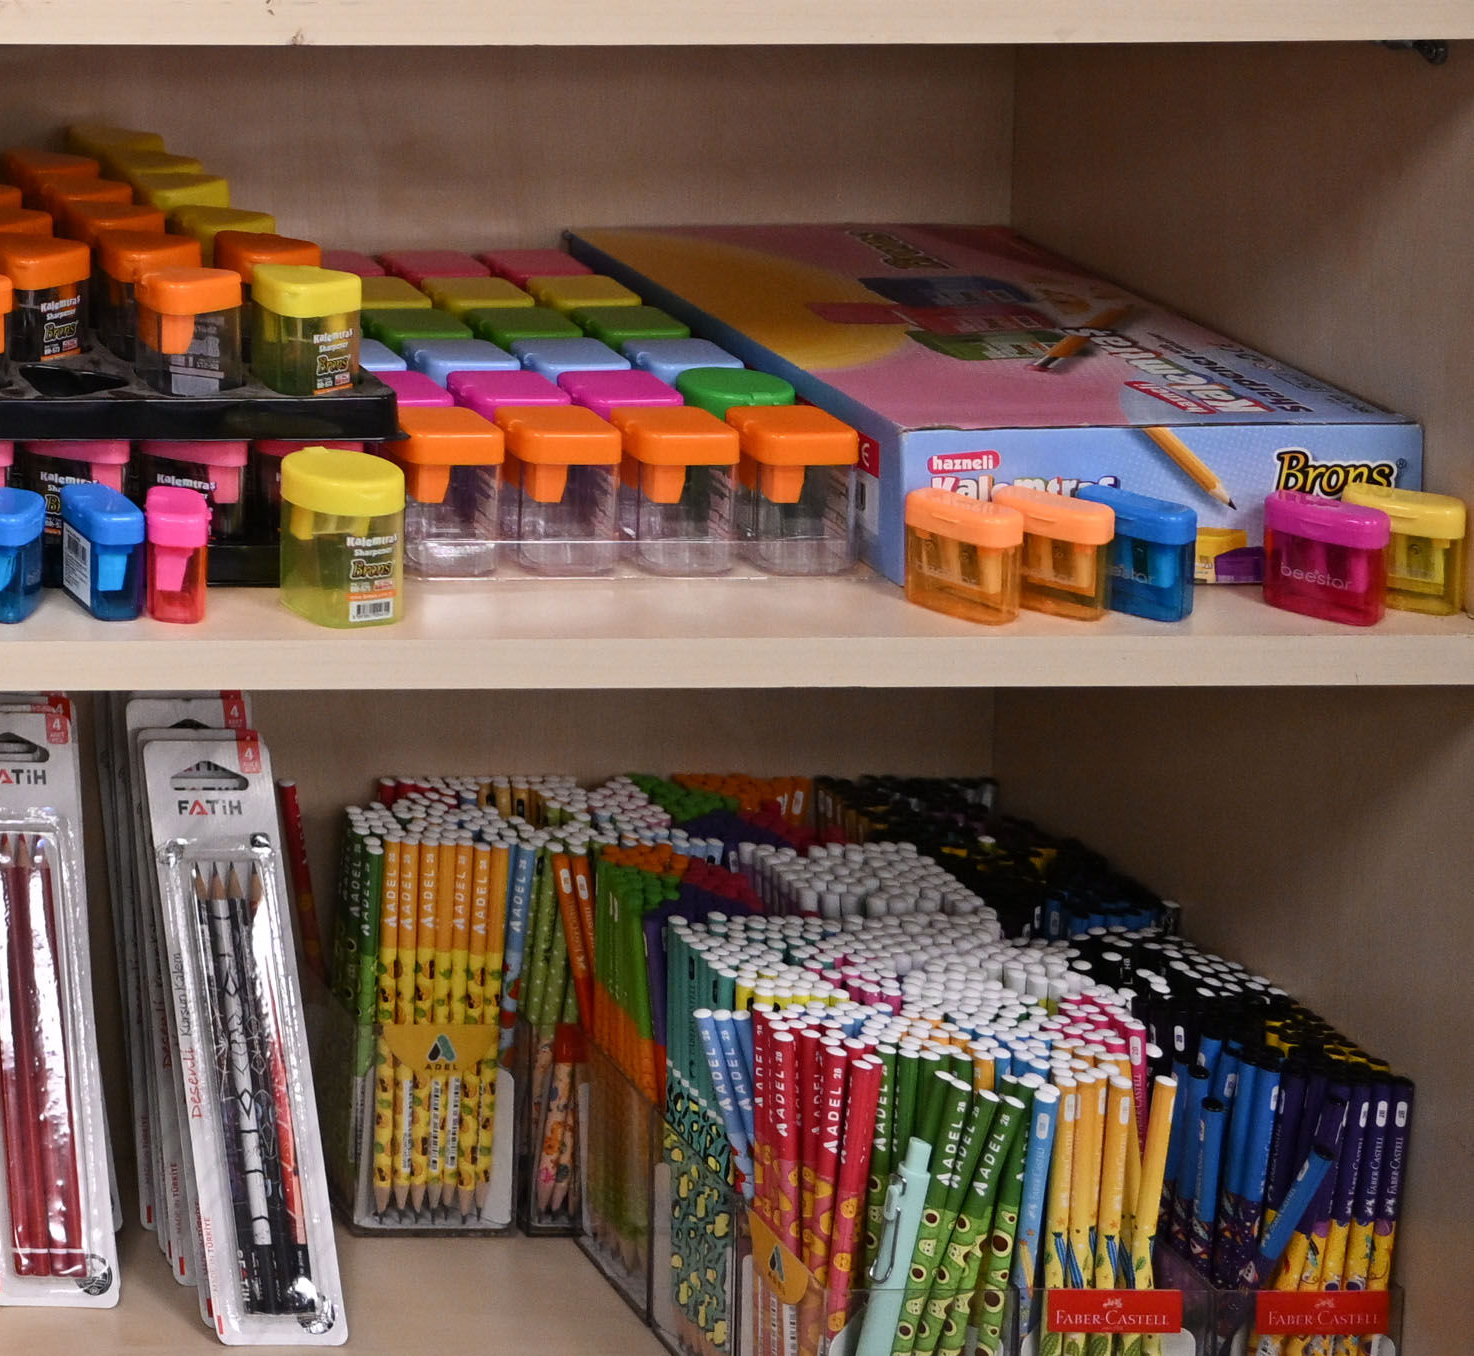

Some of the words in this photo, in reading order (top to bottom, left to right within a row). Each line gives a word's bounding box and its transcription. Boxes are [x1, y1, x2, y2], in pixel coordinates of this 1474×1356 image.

[931, 455, 993, 470] hazneli
[1276, 450, 1394, 499] Brons
[244, 750, 253, 760] 4
[456, 872, 466, 914] ADEL
[476, 876, 487, 919] ADEL
[513, 876, 526, 916] ADEL
[182, 1047, 203, 1120] Desenli
[424, 1062, 458, 1072] ADEL
[708, 1048, 728, 1095] ADEL
[725, 1048, 746, 1095] ADEL
[832, 1068, 842, 1079] 2B
[775, 1070, 786, 1119] ADEL
[826, 1087, 841, 1136] ADEL
[942, 1120, 962, 1168] ADEL
[956, 1101, 966, 1113] 2B
[980, 1133, 1005, 1180] ADEL
[1000, 1115, 1011, 1127] 2B
[1368, 1136, 1385, 1195] FABER-CASTELL
[1387, 1136, 1405, 1195] FABER-CASTELL
[202, 1217, 214, 1254] TÜRKİYE
[1055, 1309, 1169, 1326] FABER-CASTELL
[1267, 1310, 1378, 1327] FABER-CASTELL
